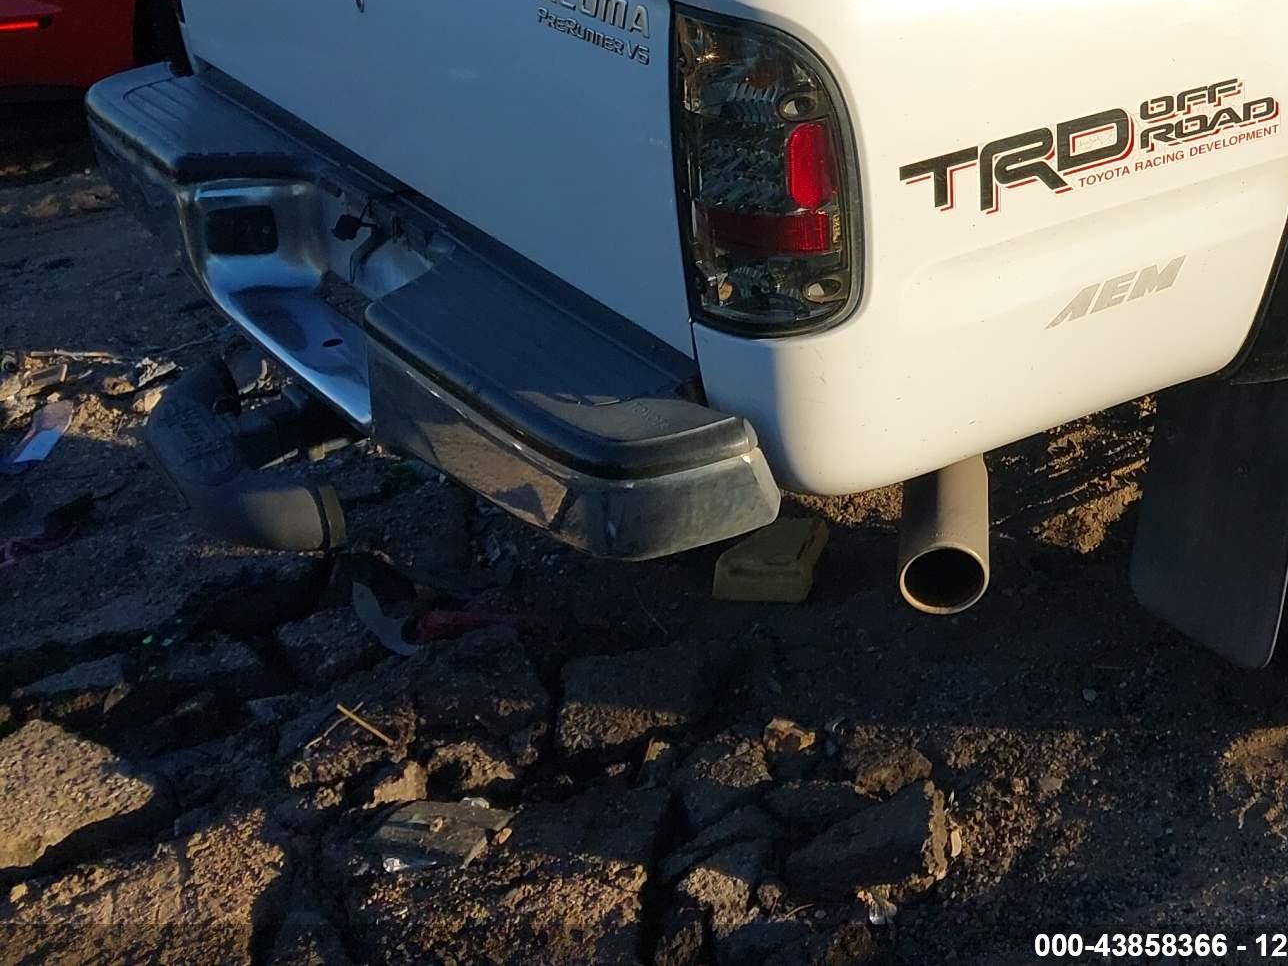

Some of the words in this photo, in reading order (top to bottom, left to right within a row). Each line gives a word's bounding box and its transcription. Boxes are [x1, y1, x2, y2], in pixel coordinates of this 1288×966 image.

[1139, 77, 1244, 124] OFF
[1140, 96, 1280, 153] ROAD
[899, 108, 1135, 215] TRD
[1078, 166, 1131, 189] TOYOTA
[1134, 150, 1185, 172] RACING
[1189, 123, 1280, 157] DEVELOPMENT
[1044, 254, 1187, 331] AEM
